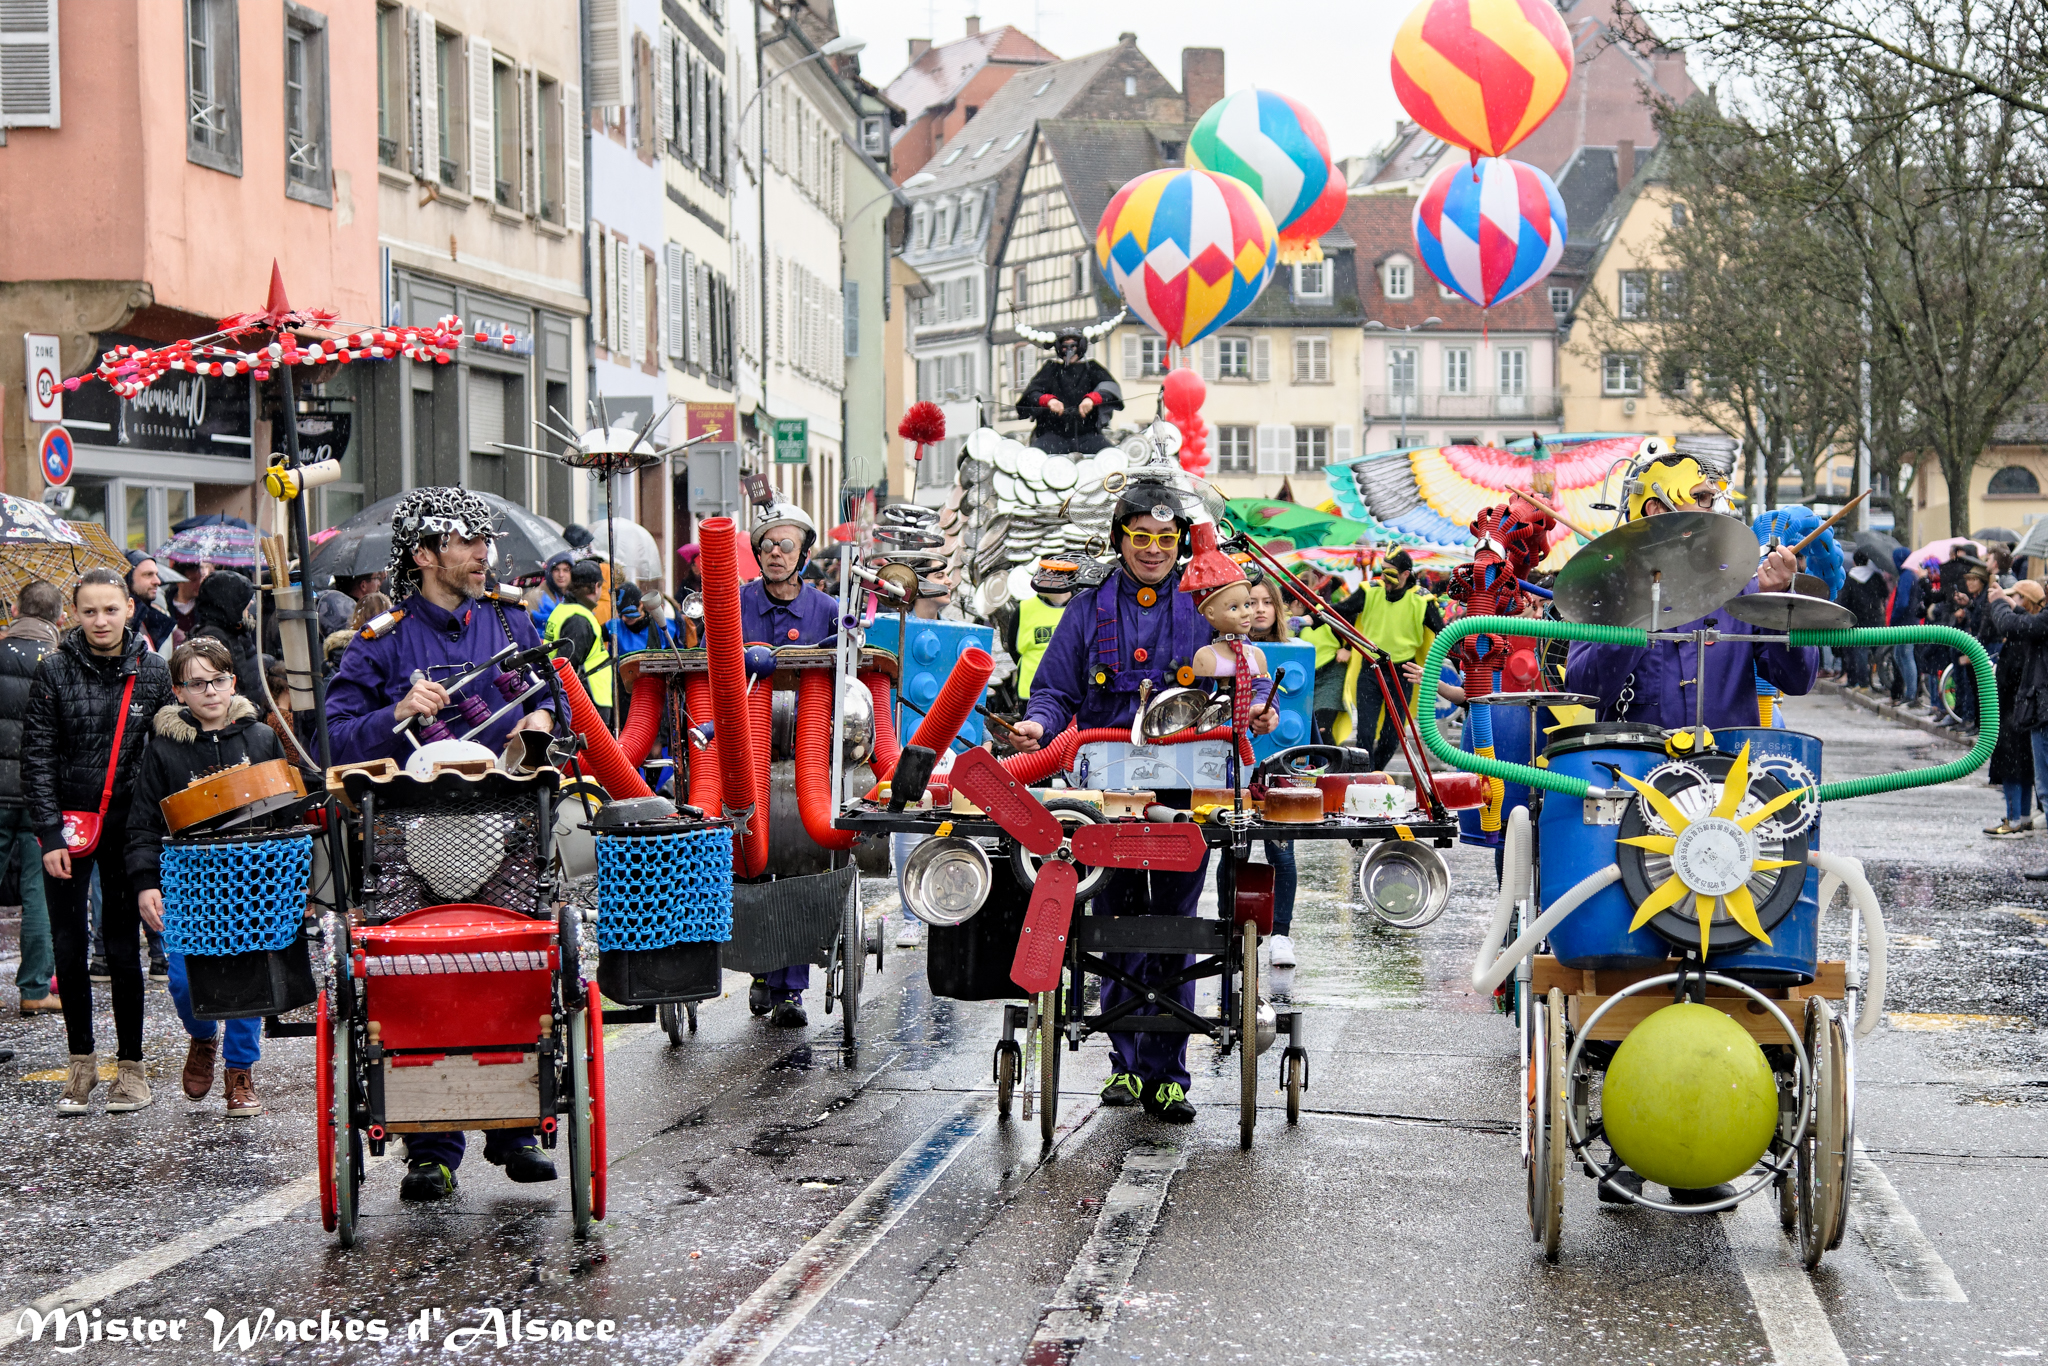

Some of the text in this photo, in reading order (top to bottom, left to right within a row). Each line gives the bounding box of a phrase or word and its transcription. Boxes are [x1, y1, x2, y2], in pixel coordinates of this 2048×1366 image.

[35, 345, 54, 358] ZONE
[40, 379, 52, 396] 30
[133, 422, 197, 440] RESTAURANT
